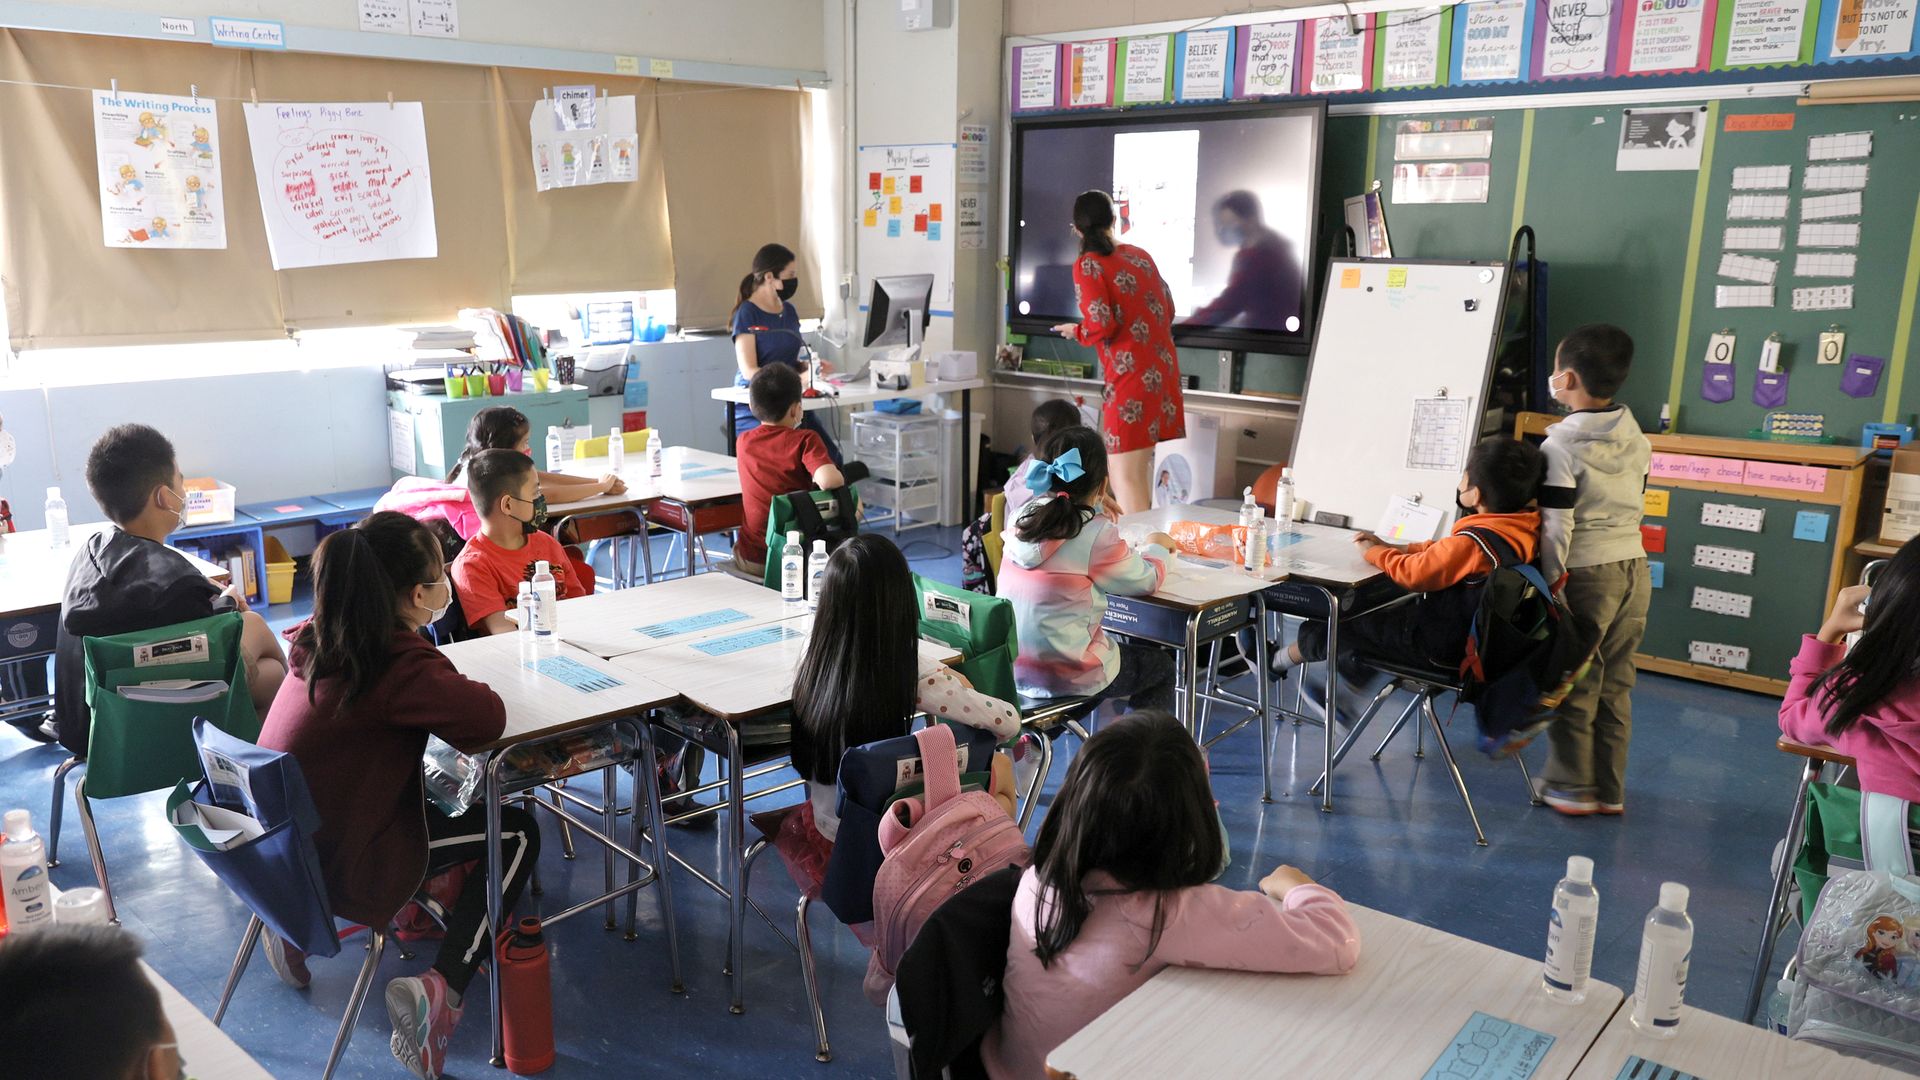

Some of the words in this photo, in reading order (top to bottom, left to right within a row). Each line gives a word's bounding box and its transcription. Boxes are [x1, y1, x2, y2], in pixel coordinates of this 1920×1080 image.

[1553, 3, 1587, 19] NEVER
[1842, 13, 1857, 24] BUT
[1858, 12, 1876, 23] IT'S
[1877, 11, 1895, 21] NOT
[1896, 10, 1908, 19] OK
[162, 22, 188, 31] North
[215, 24, 250, 41] Writing
[252, 27, 279, 41] Center
[1858, 26, 1868, 35] TO
[1869, 24, 1888, 35] NOT
[1189, 44, 1218, 56] BELIEVE
[1748, 44, 1761, 52] you
[1858, 38, 1886, 53] try.
[1252, 53, 1269, 61] that
[1260, 63, 1277, 71] are
[100, 96, 122, 107] The
[124, 98, 169, 112] Writing
[171, 101, 211, 114] Process
[276, 107, 312, 121] Feelings
[320, 107, 342, 121] Piggy
[1715, 342, 1729, 361] 0
[1824, 341, 1839, 361] 0
[1652, 458, 1666, 472] We
[1669, 461, 1710, 478] earn/keep
[1717, 464, 1743, 477] choice
[1747, 469, 1764, 480] time
[1770, 472, 1801, 485] minutes
[1207, 610, 1238, 624] HAMMERMILL
[1709, 655, 1726, 664] up
